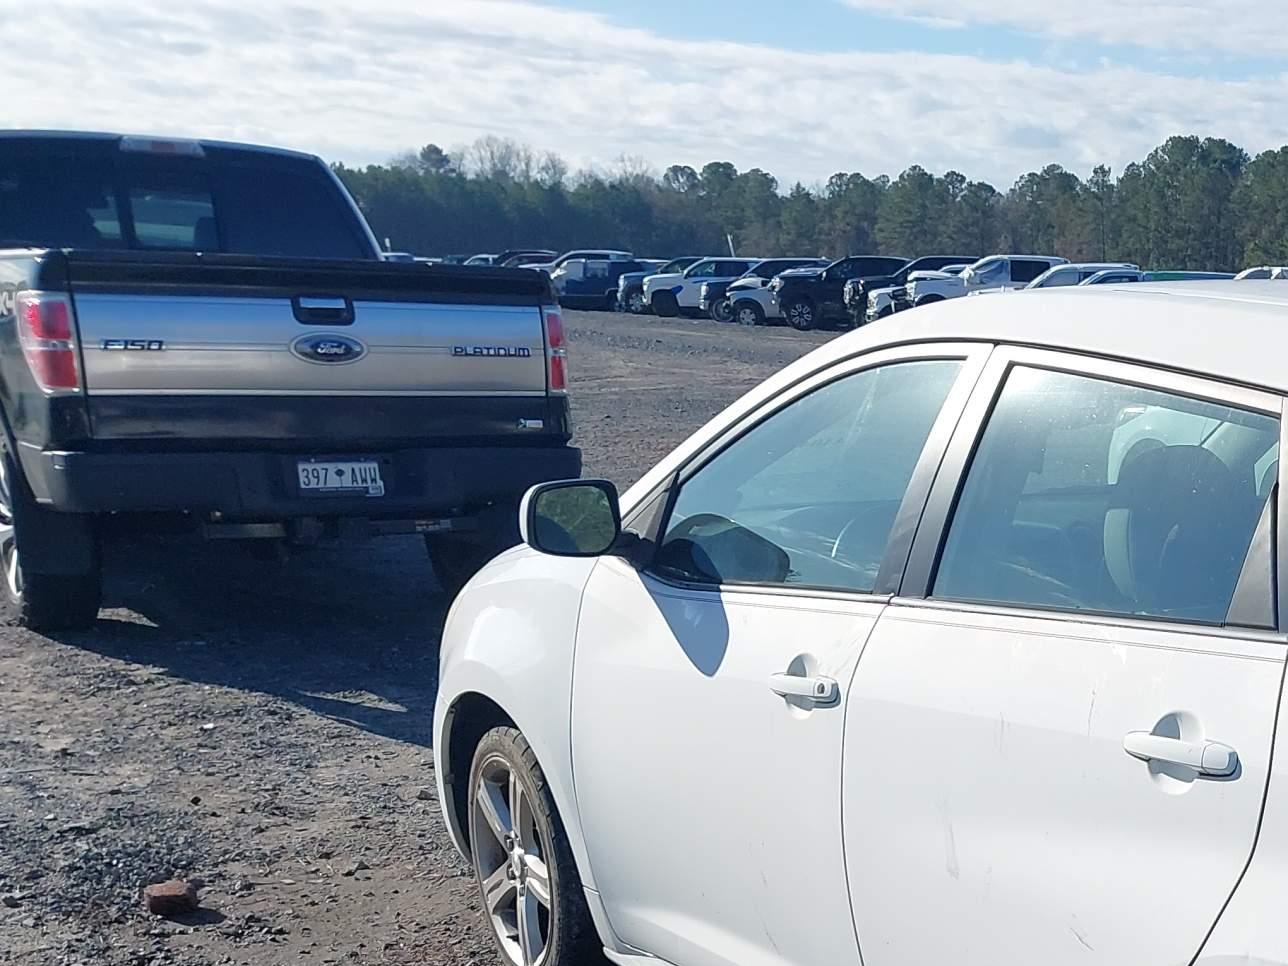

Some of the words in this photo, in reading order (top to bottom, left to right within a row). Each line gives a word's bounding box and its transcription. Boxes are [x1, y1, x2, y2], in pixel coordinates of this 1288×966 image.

[317, 342, 346, 354] Ford
[452, 346, 531, 358] PLATINUM
[301, 467, 328, 487] 397
[351, 466, 378, 486] AWW
